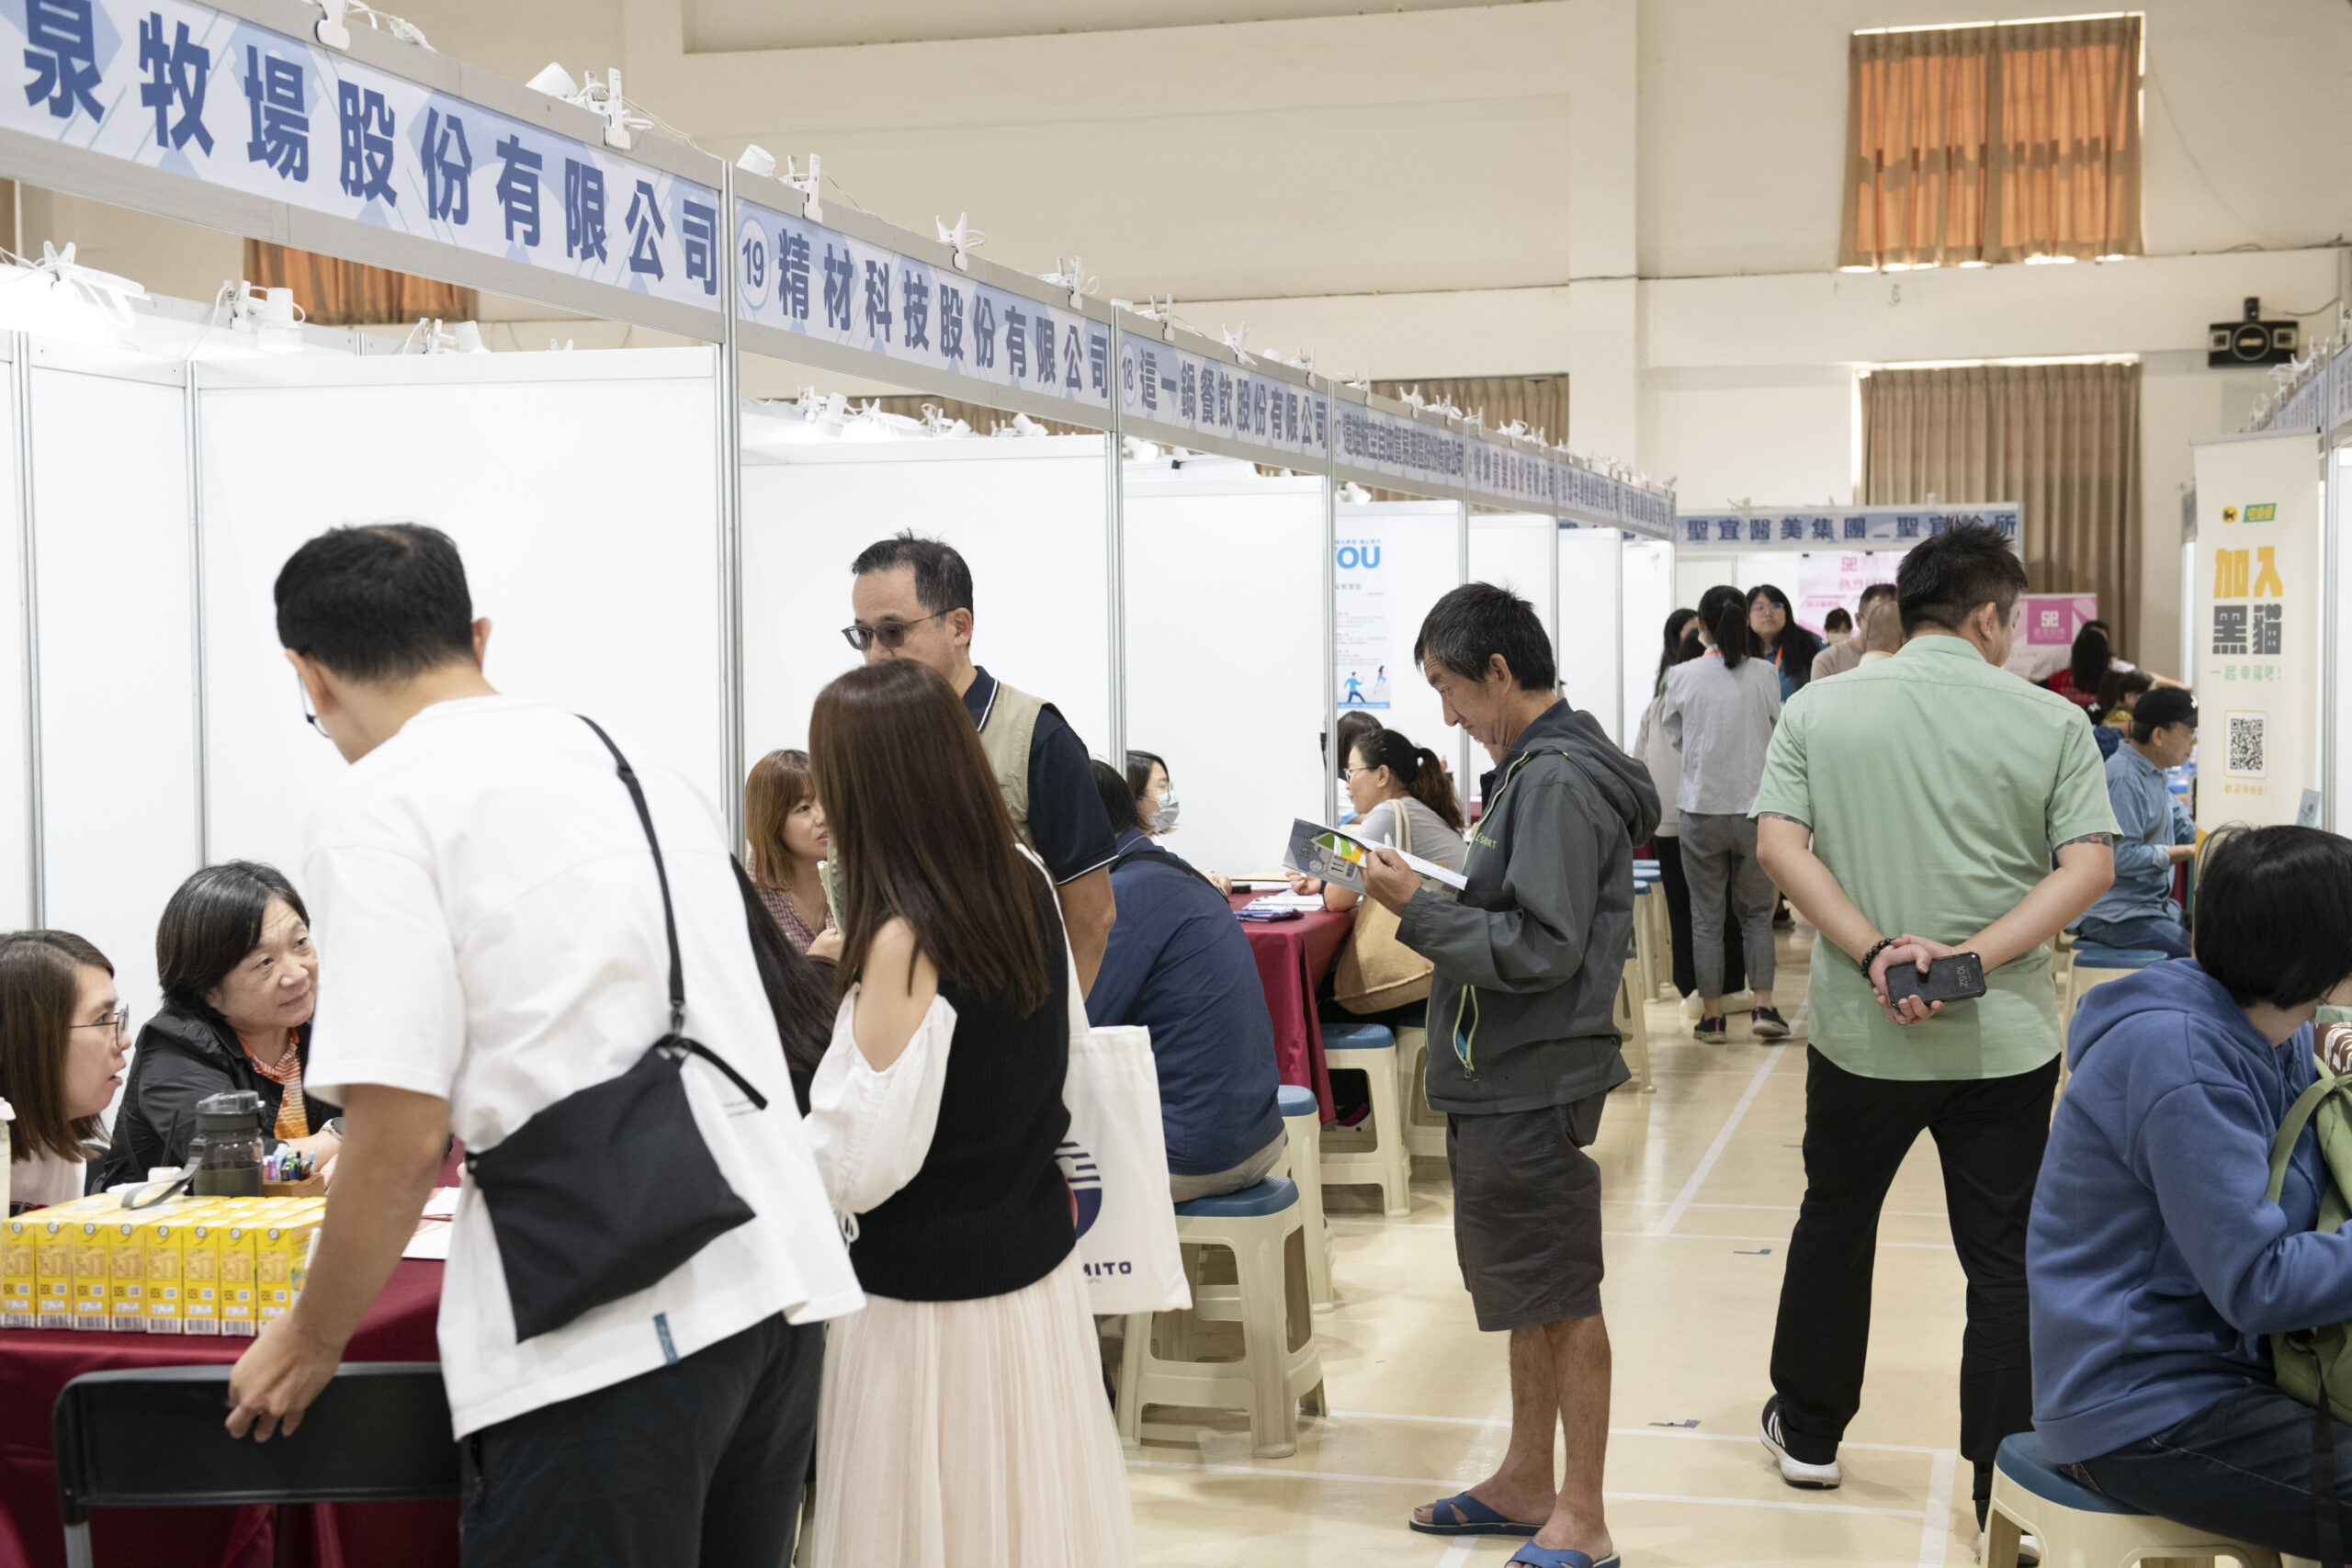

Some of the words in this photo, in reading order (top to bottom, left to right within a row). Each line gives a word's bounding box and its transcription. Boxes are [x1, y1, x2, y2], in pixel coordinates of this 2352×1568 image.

[23, 0, 717, 296] 泉牧場股份有限公司
[742, 238, 764, 288] 19
[778, 228, 1108, 399] 精材科技股份有限公司
[1121, 356, 1134, 391] 18
[1139, 345, 1327, 449] 這一鍋餐飲股份有限公司
[1687, 514, 2017, 541] 聖宜醫美集團_聖宜所
[1335, 546, 1381, 570] OU
[2213, 546, 2284, 600] 加入
[2211, 604, 2283, 655] 黑貓
